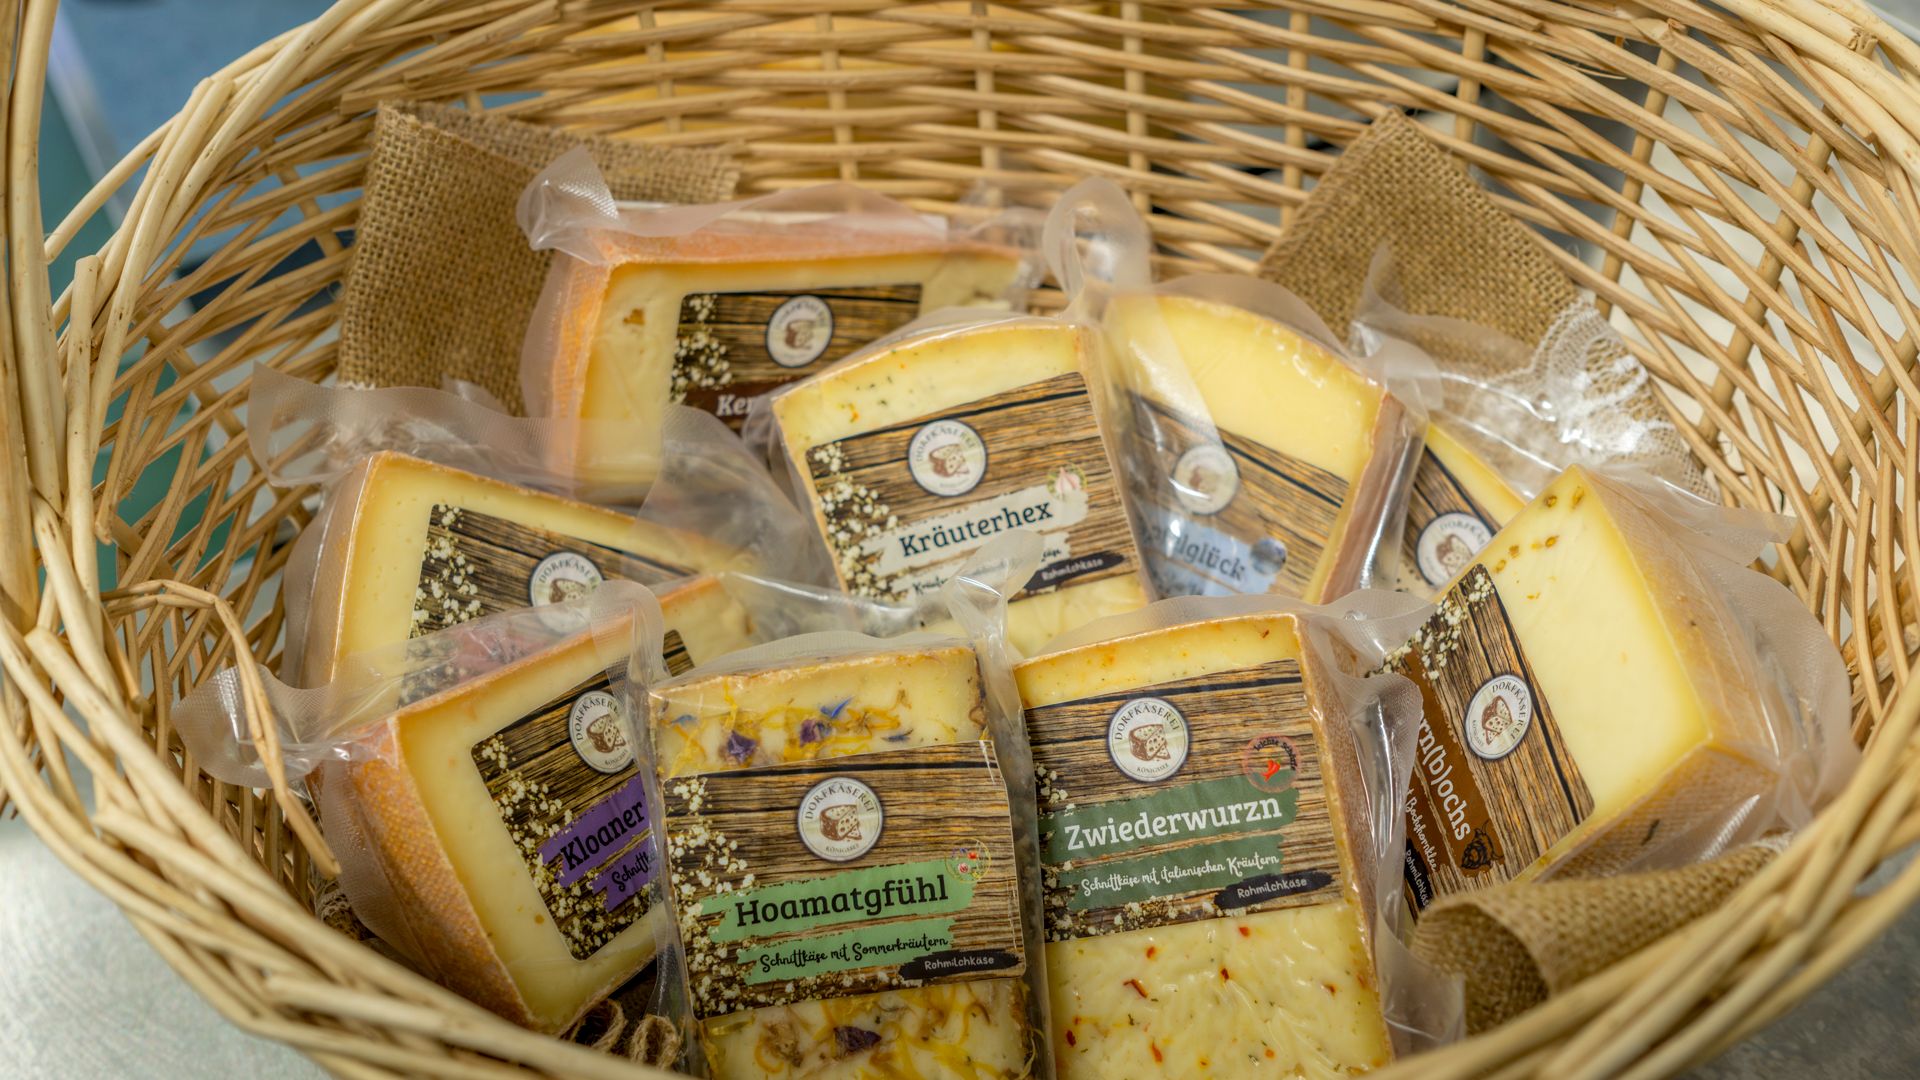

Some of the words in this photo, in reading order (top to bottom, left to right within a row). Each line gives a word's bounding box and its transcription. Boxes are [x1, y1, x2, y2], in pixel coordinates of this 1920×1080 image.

[900, 502, 1053, 557] Kräuterhex
[1114, 702, 1180, 741] DORFKÄSEREI
[1492, 681, 1526, 740] DORFKÄSEREI
[804, 782, 876, 820] DORFKÄSEREI
[1064, 797, 1283, 851] Zwiederwurzn
[559, 801, 645, 872] Kloaner
[1080, 874, 1140, 898] Schnittkäse
[1141, 867, 1161, 886] mit
[1160, 862, 1226, 881] italienischen
[1225, 850, 1280, 878] Kräutern
[1236, 877, 1309, 900] Rohmilchkäse
[735, 874, 949, 928] Hoamatgfühl
[760, 943, 828, 973] Schnittkäse
[830, 944, 850, 963] mit
[852, 933, 948, 961] Sommerkräutern
[924, 956, 995, 971] Rohmilchkäse
